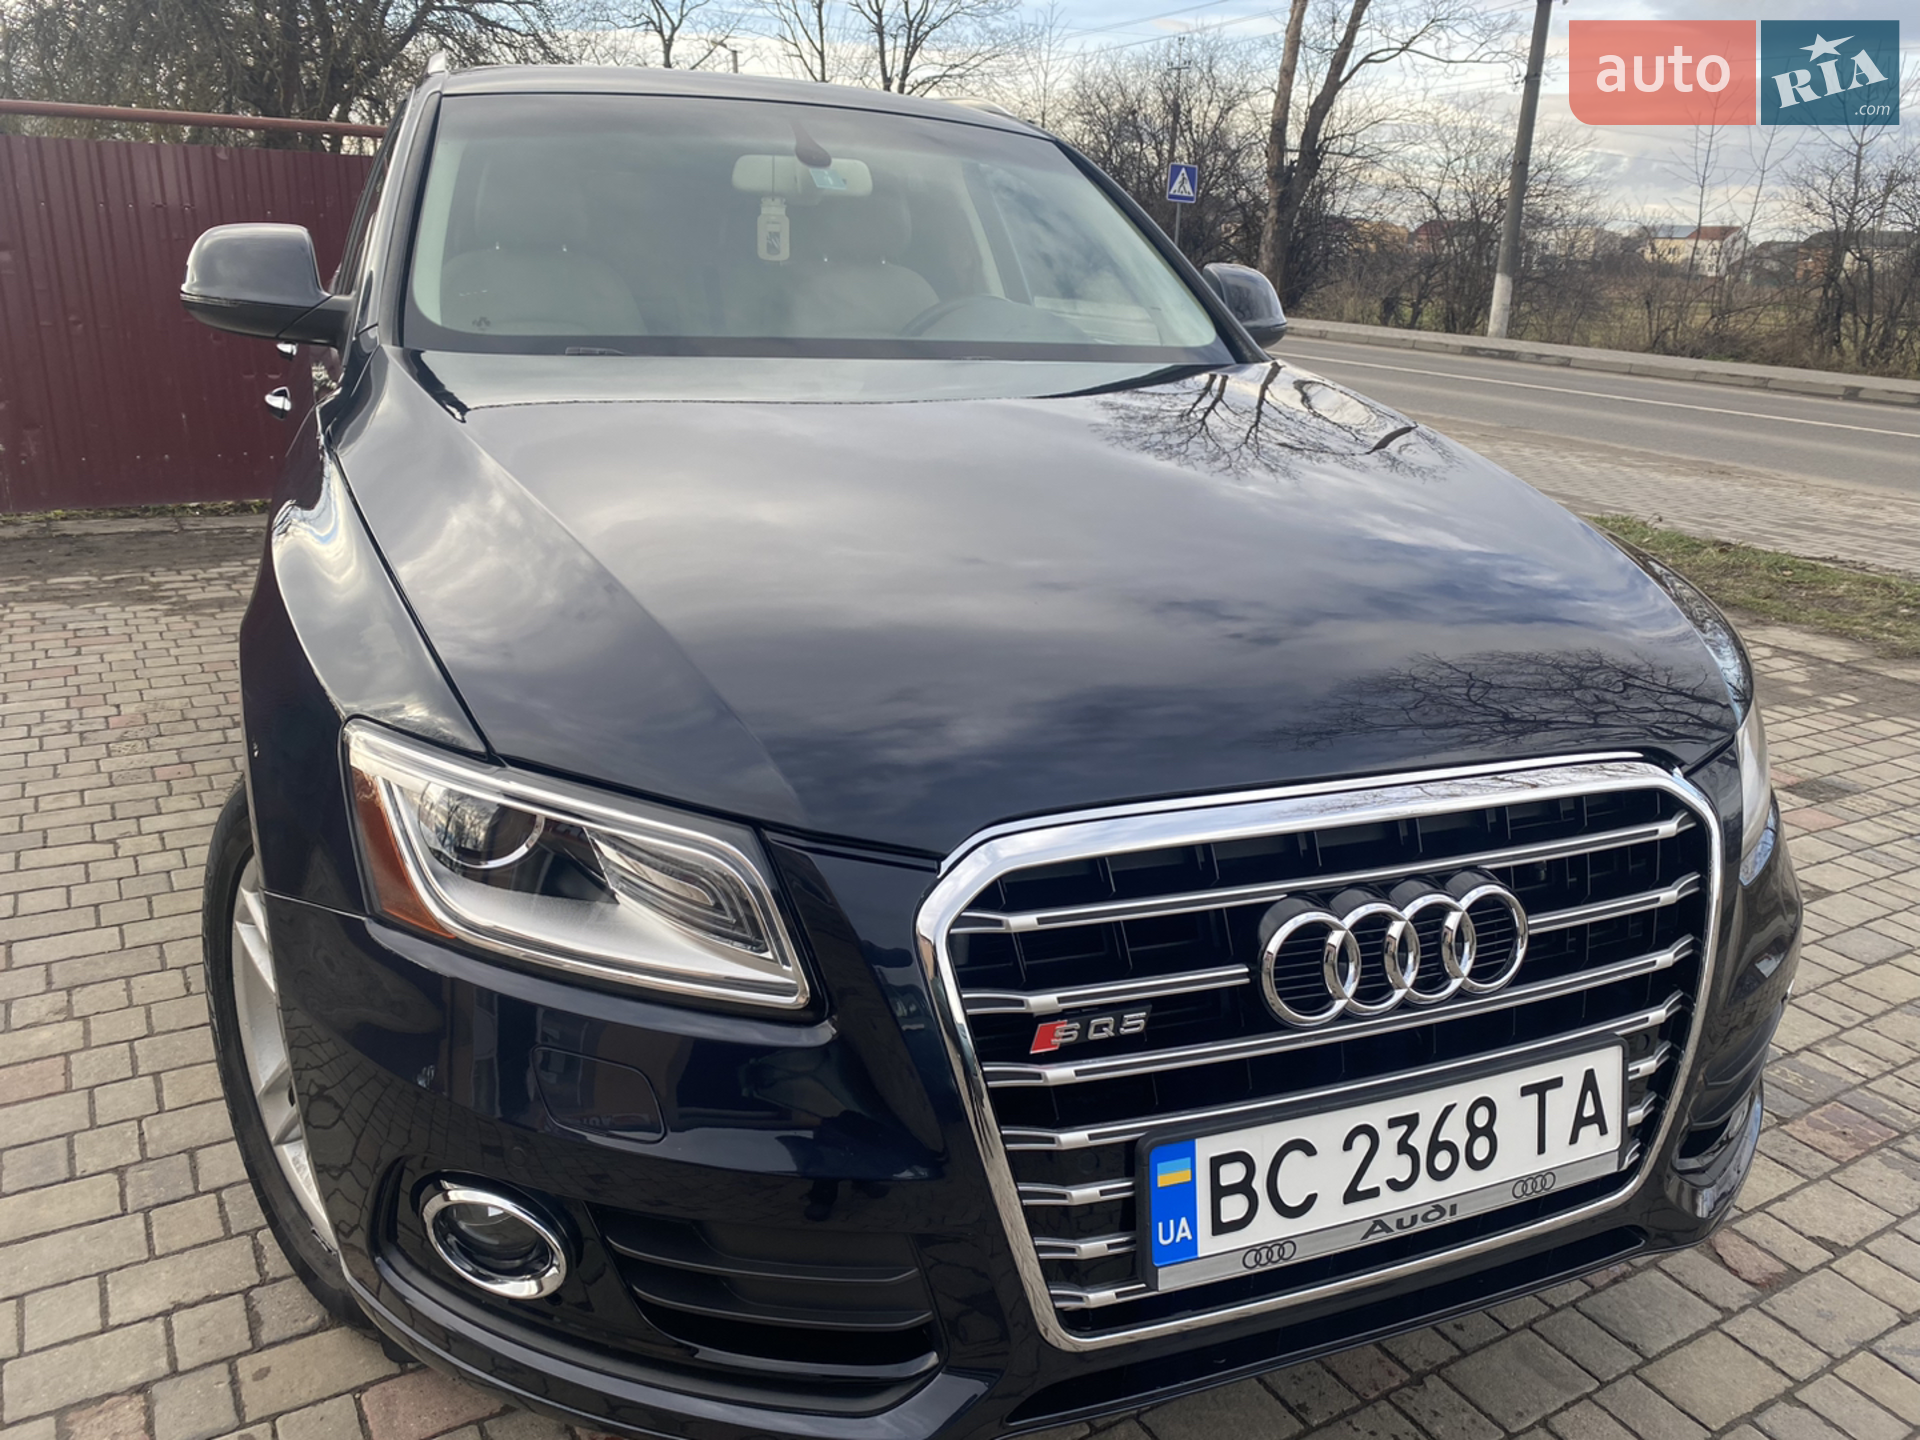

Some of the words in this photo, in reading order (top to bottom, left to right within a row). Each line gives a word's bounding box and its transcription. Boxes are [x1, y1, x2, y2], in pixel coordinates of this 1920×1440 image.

[1050, 1012, 1147, 1044] SQ5
[1209, 1138, 1318, 1237] BC
[1342, 1095, 1498, 1205] 2368
[1520, 1067, 1608, 1156] TA
[1157, 1216, 1192, 1246] UA
[1360, 1203, 1458, 1241] Audi
